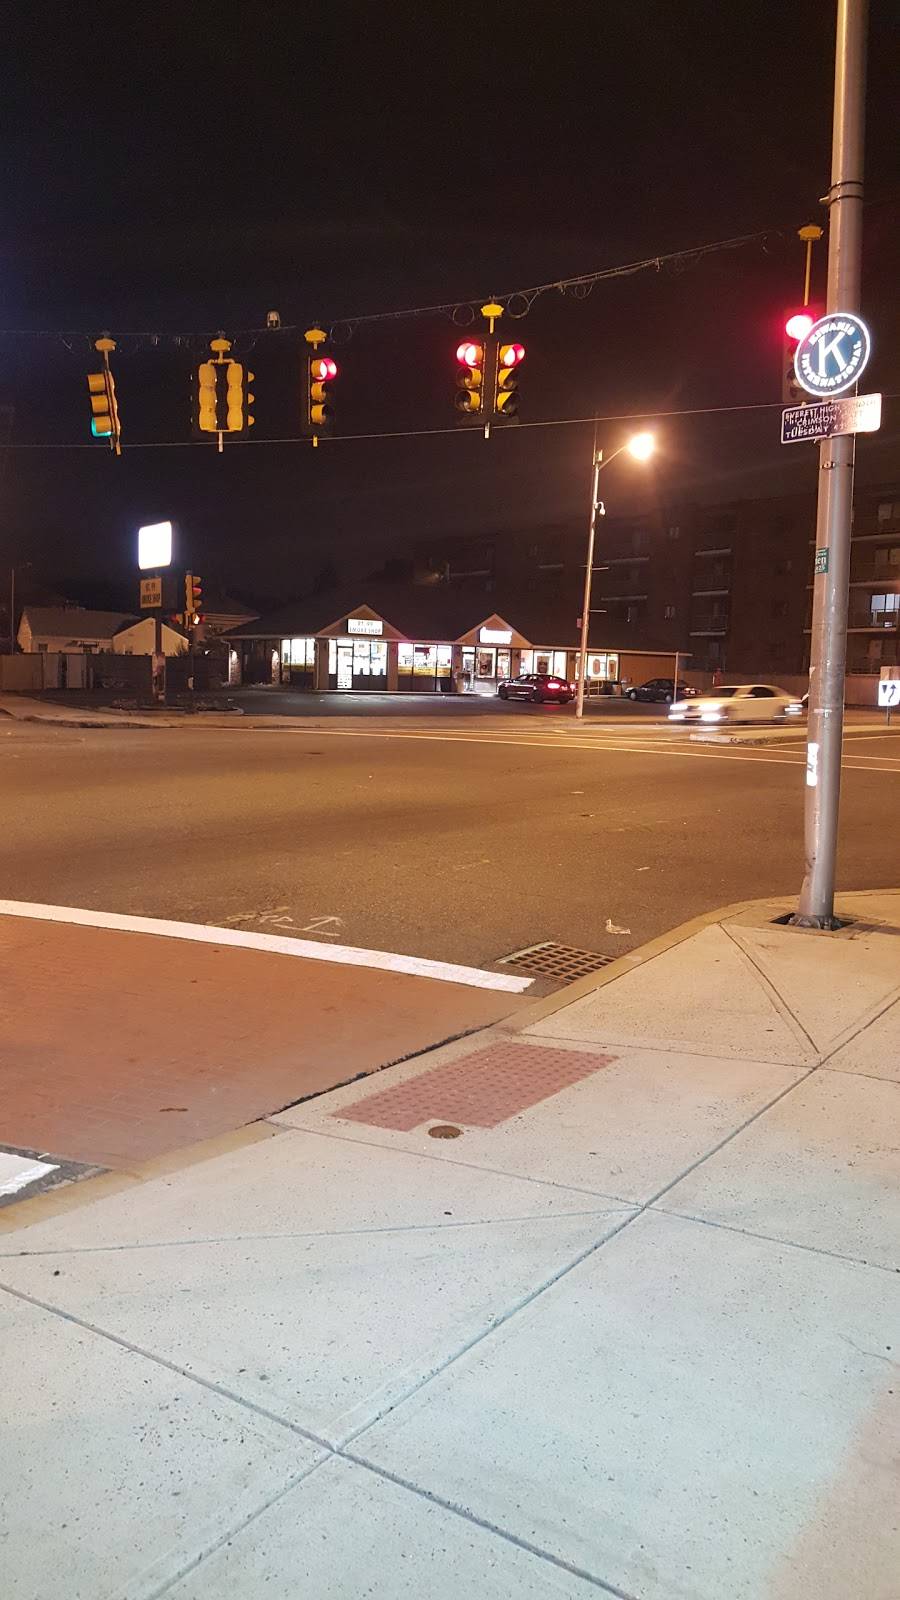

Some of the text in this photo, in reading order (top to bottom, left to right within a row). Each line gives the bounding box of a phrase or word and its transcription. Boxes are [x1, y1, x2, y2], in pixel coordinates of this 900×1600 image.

[808, 322, 855, 345] KIWANIS
[818, 331, 848, 378] K
[801, 340, 862, 388] INTERNATIONAL
[785, 407, 819, 420] EVERETT
[797, 414, 836, 427] CRIMSON
[785, 425, 828, 438] TUESDAY
